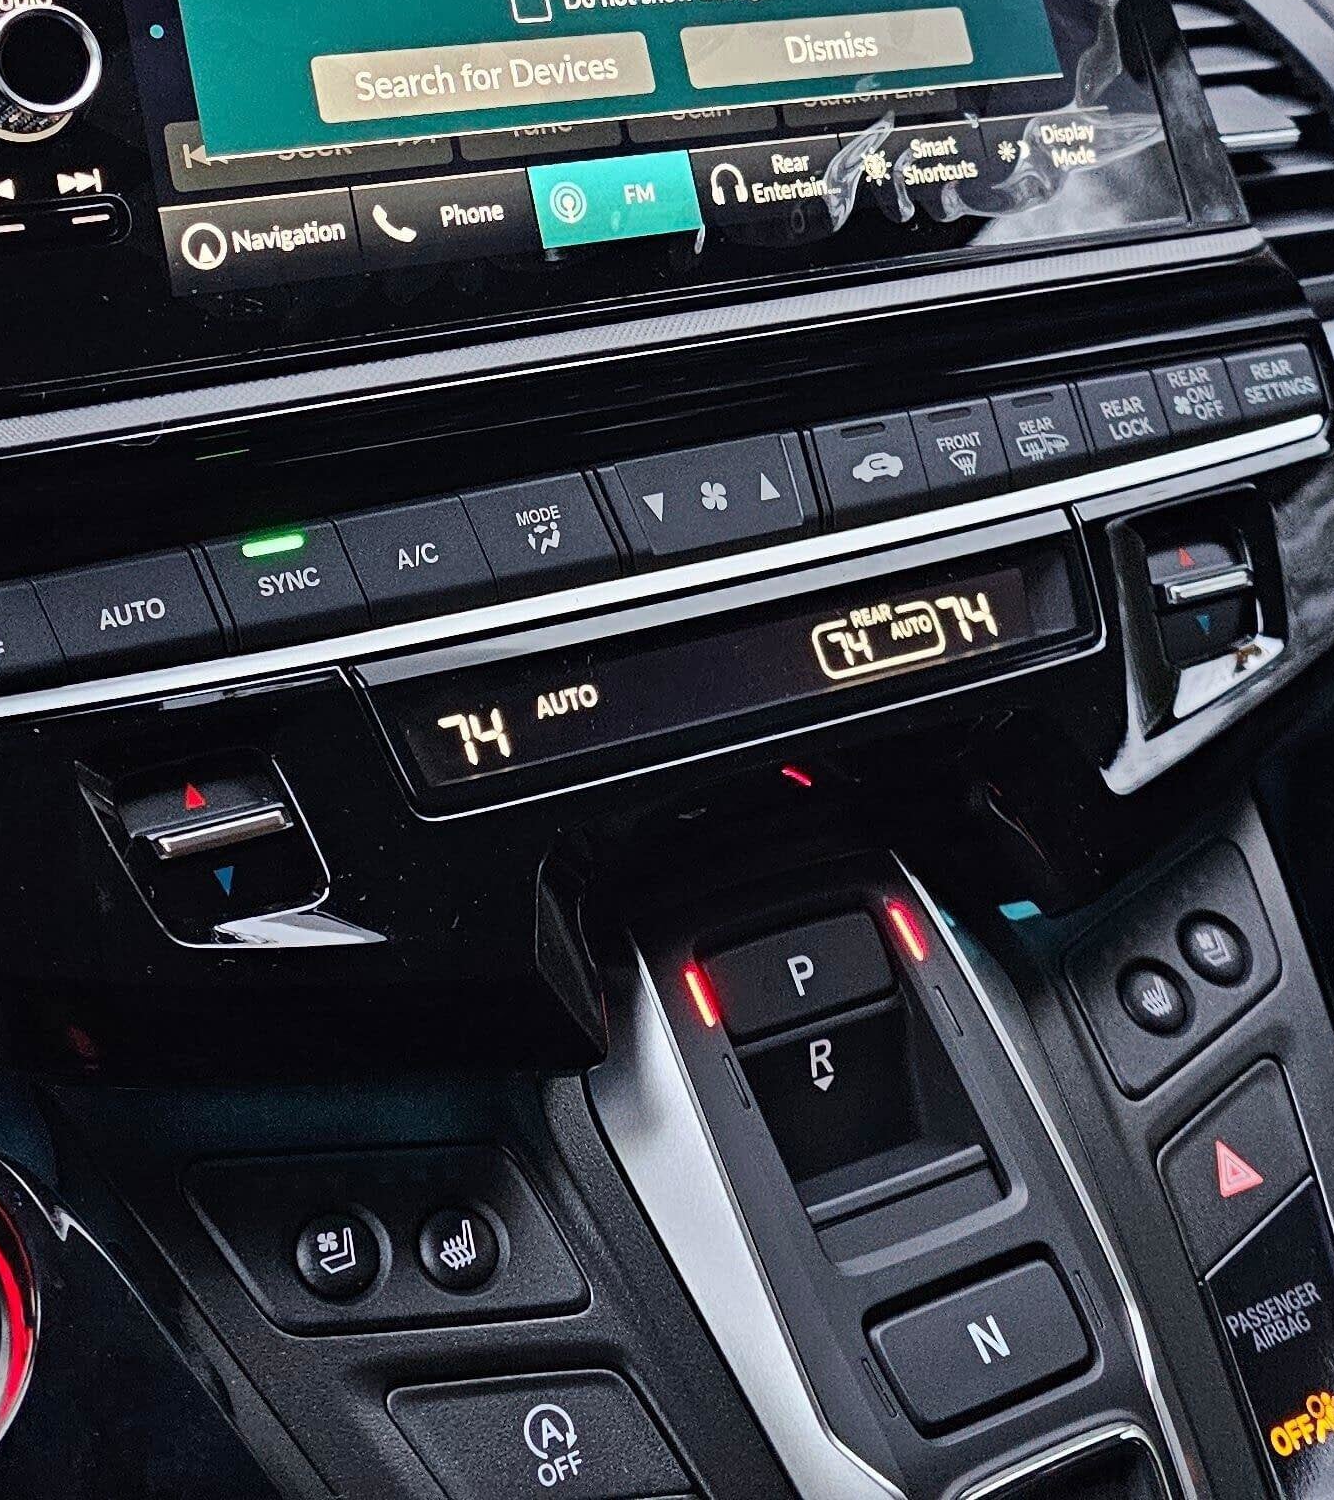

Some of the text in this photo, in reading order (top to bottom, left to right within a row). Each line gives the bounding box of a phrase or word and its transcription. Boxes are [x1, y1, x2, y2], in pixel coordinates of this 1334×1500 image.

[784, 31, 878, 65] Dismiss
[355, 54, 619, 101] Search for Devices
[910, 136, 958, 158] Smart
[1040, 123, 1095, 146] Display
[771, 154, 810, 175] Rear
[1051, 148, 1096, 168] Mode
[903, 162, 978, 186] Shortcuts
[623, 182, 656, 205] FM
[440, 203, 505, 228] Phone
[232, 220, 346, 253] Navigation
[1167, 367, 1212, 389] REAR
[1249, 359, 1293, 381] REAR
[1186, 384, 1215, 405] ON/
[1244, 376, 1318, 405] SETTINGS
[1099, 396, 1146, 420] REAR
[1194, 400, 1225, 421] OFF
[1019, 416, 1055, 435] REAR
[1109, 416, 1156, 441] LOCK
[936, 431, 981, 453] FRONT
[515, 504, 561, 528] MODE
[397, 543, 440, 571] A/C
[257, 566, 321, 598] SYNC
[99, 597, 166, 631] AUTO
[849, 603, 893, 629] REAR
[935, 592, 998, 643] 74
[826, 614, 932, 666] 74 AUTO
[437, 684, 599, 767] 74 AUTO
[787, 955, 815, 997] P
[808, 1039, 834, 1077] R
[1225, 1281, 1321, 1338] PASSENGER
[966, 1314, 1012, 1365] N
[1251, 1310, 1311, 1353] AIRBAG
[1270, 1413, 1315, 1457] OFF
[537, 1450, 583, 1487] OFF
